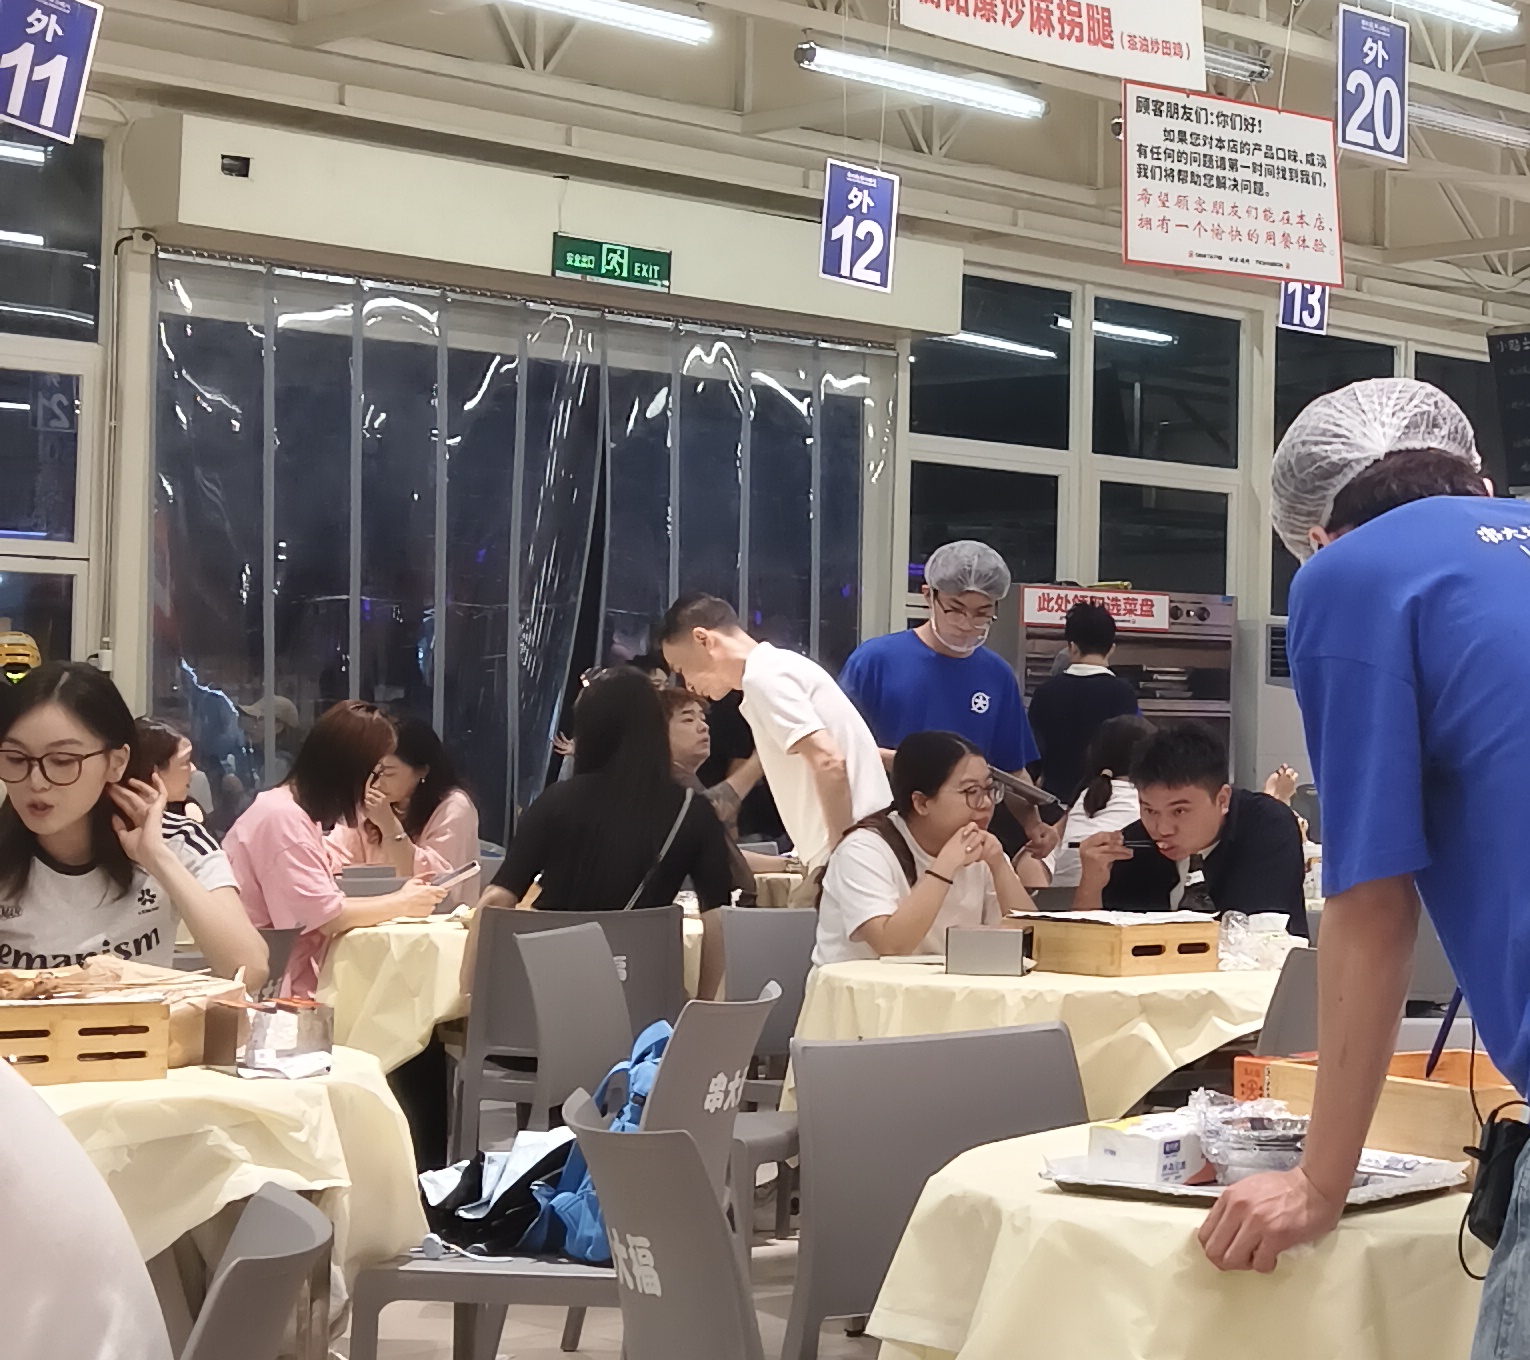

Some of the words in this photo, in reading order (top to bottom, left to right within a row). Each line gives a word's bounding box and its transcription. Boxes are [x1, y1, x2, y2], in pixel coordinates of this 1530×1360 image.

[25, 8, 64, 42] 外
[1363, 37, 1389, 68] 外
[0, 42, 69, 128] 11
[1345, 69, 1401, 153] 20
[847, 186, 875, 213] 外
[831, 215, 884, 285] 12
[634, 262, 660, 279] EXIT
[1287, 282, 1322, 327] 13
